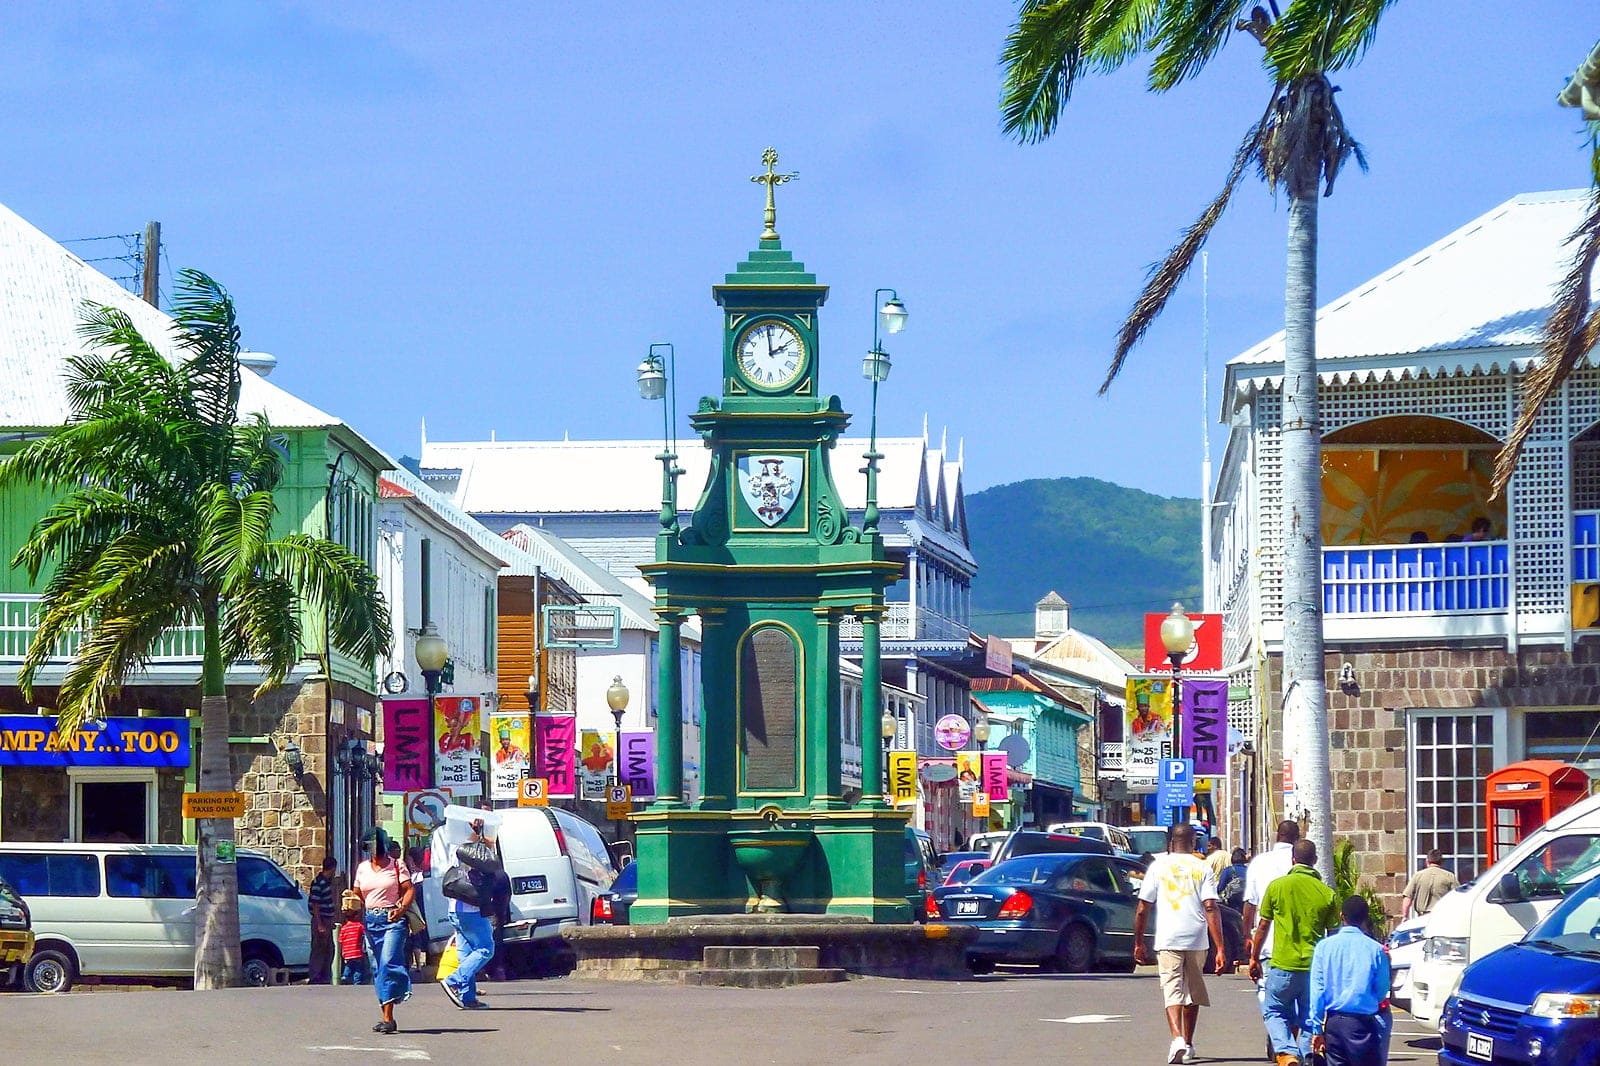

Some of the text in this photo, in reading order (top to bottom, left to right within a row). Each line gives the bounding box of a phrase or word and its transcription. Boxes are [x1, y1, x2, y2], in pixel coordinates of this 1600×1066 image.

[395, 708, 420, 782] LIME
[546, 724, 567, 785] LIME
[1193, 690, 1219, 764] LIME
[628, 738, 648, 790] LIME
[897, 758, 911, 796] LIME
[989, 758, 1004, 798] LIME
